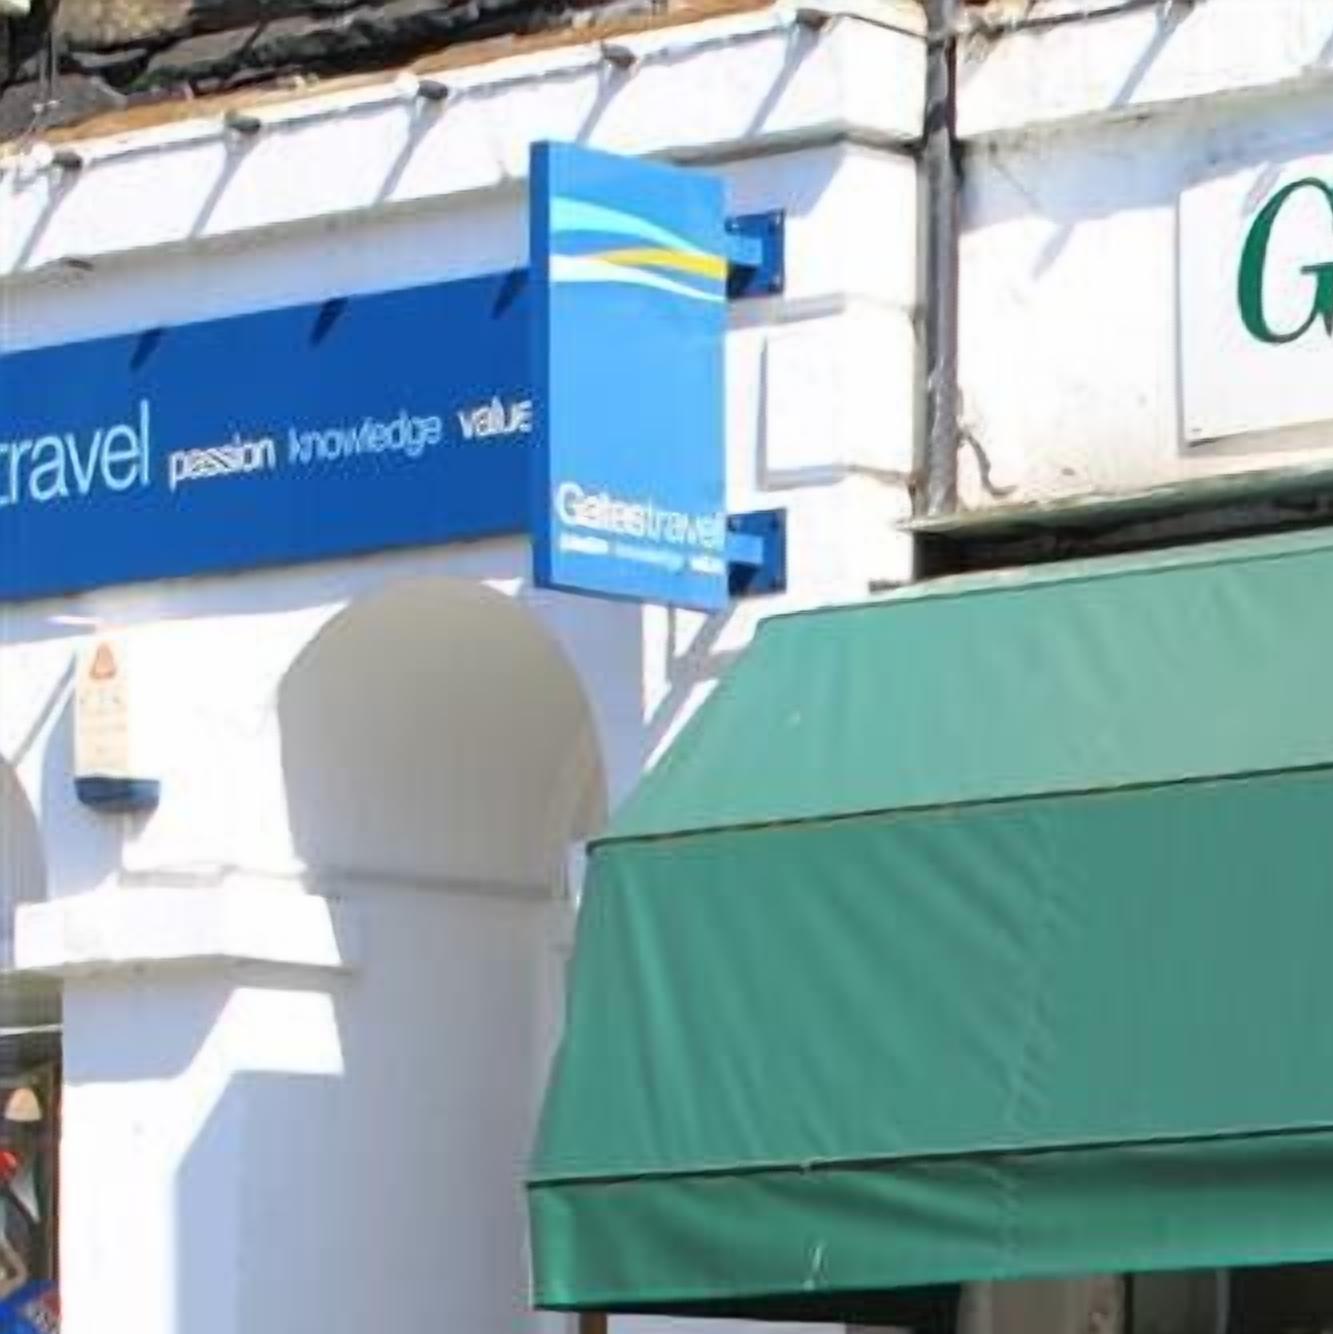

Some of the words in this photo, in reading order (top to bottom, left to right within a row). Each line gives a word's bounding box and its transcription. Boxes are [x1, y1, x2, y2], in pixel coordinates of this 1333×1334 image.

[168, 433, 276, 491] passion
[288, 408, 441, 460] knowledge
[457, 396, 533, 439] value
